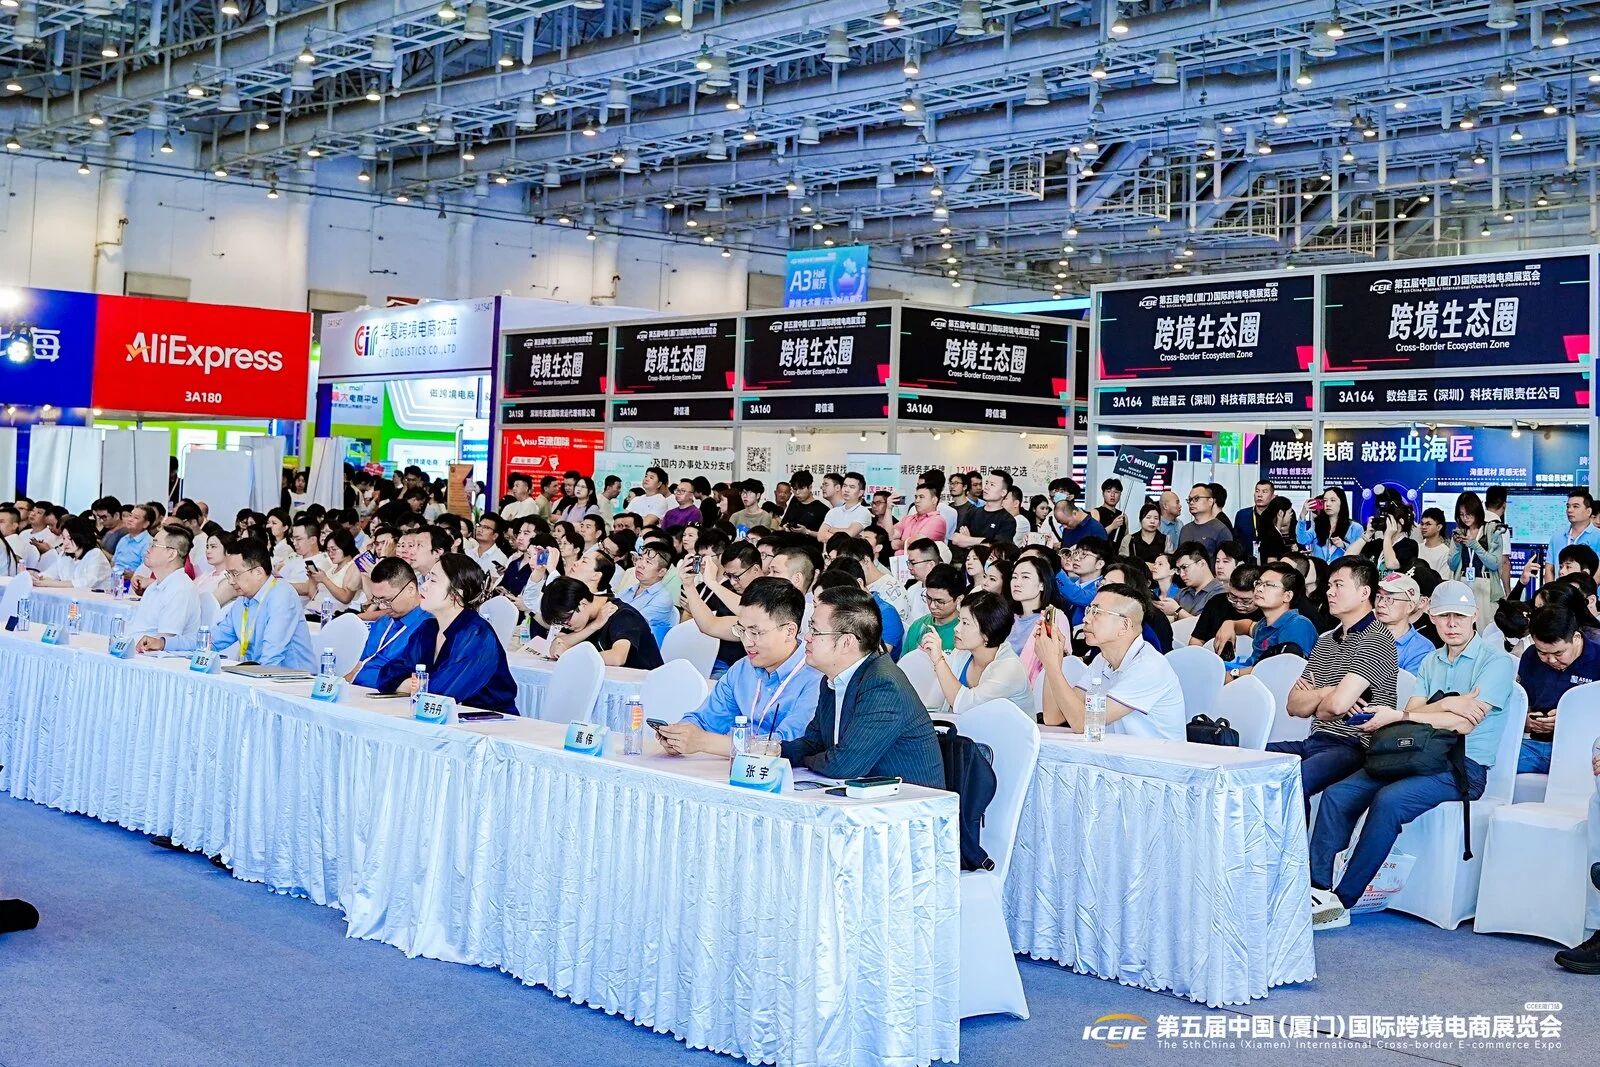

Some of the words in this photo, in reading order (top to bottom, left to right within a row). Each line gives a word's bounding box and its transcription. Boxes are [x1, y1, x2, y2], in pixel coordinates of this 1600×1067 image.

[790, 270, 812, 292] A3
[1388, 296, 1519, 340] 跨境生态圈
[1154, 312, 1260, 351] 跨境生态圈
[126, 332, 283, 374] AliExpress
[391, 346, 427, 357] LOGISTICS
[779, 336, 854, 367] 跨境生态圈
[1396, 342, 1445, 352] Cross-Border
[1447, 341, 1488, 352] Ecosystem
[1490, 340, 1510, 349] Zone
[644, 345, 706, 373] 跨境生态圈
[943, 339, 1027, 374] 跨境生态圈
[1160, 352, 1201, 362] Cross-Border
[1202, 351, 1235, 361] Ecosystem
[530, 352, 584, 378] 跨境生态圈
[948, 370, 981, 379] Cross-Border
[982, 373, 1008, 382] Ecosystem
[185, 391, 222, 404] 3A180
[1113, 396, 1142, 408] 3A164
[1152, 392, 1293, 406] 数绘星云（深圳）科技有限责任公司
[1339, 390, 1374, 403] 3A164
[1386, 386, 1560, 402] 数绘星云（深圳）科技有限责任公司
[508, 410, 524, 418] 3A158
[620, 407, 638, 416] 3A160
[750, 404, 771, 414] 3A160
[815, 403, 834, 413] 跨信通
[906, 403, 933, 414] 3A160
[985, 409, 1007, 419] 跨信通
[636, 440, 660, 450] 跨信通
[1361, 441, 1397, 462] 就找
[1399, 435, 1474, 462] 出海匠
[746, 764, 769, 780] 张宇
